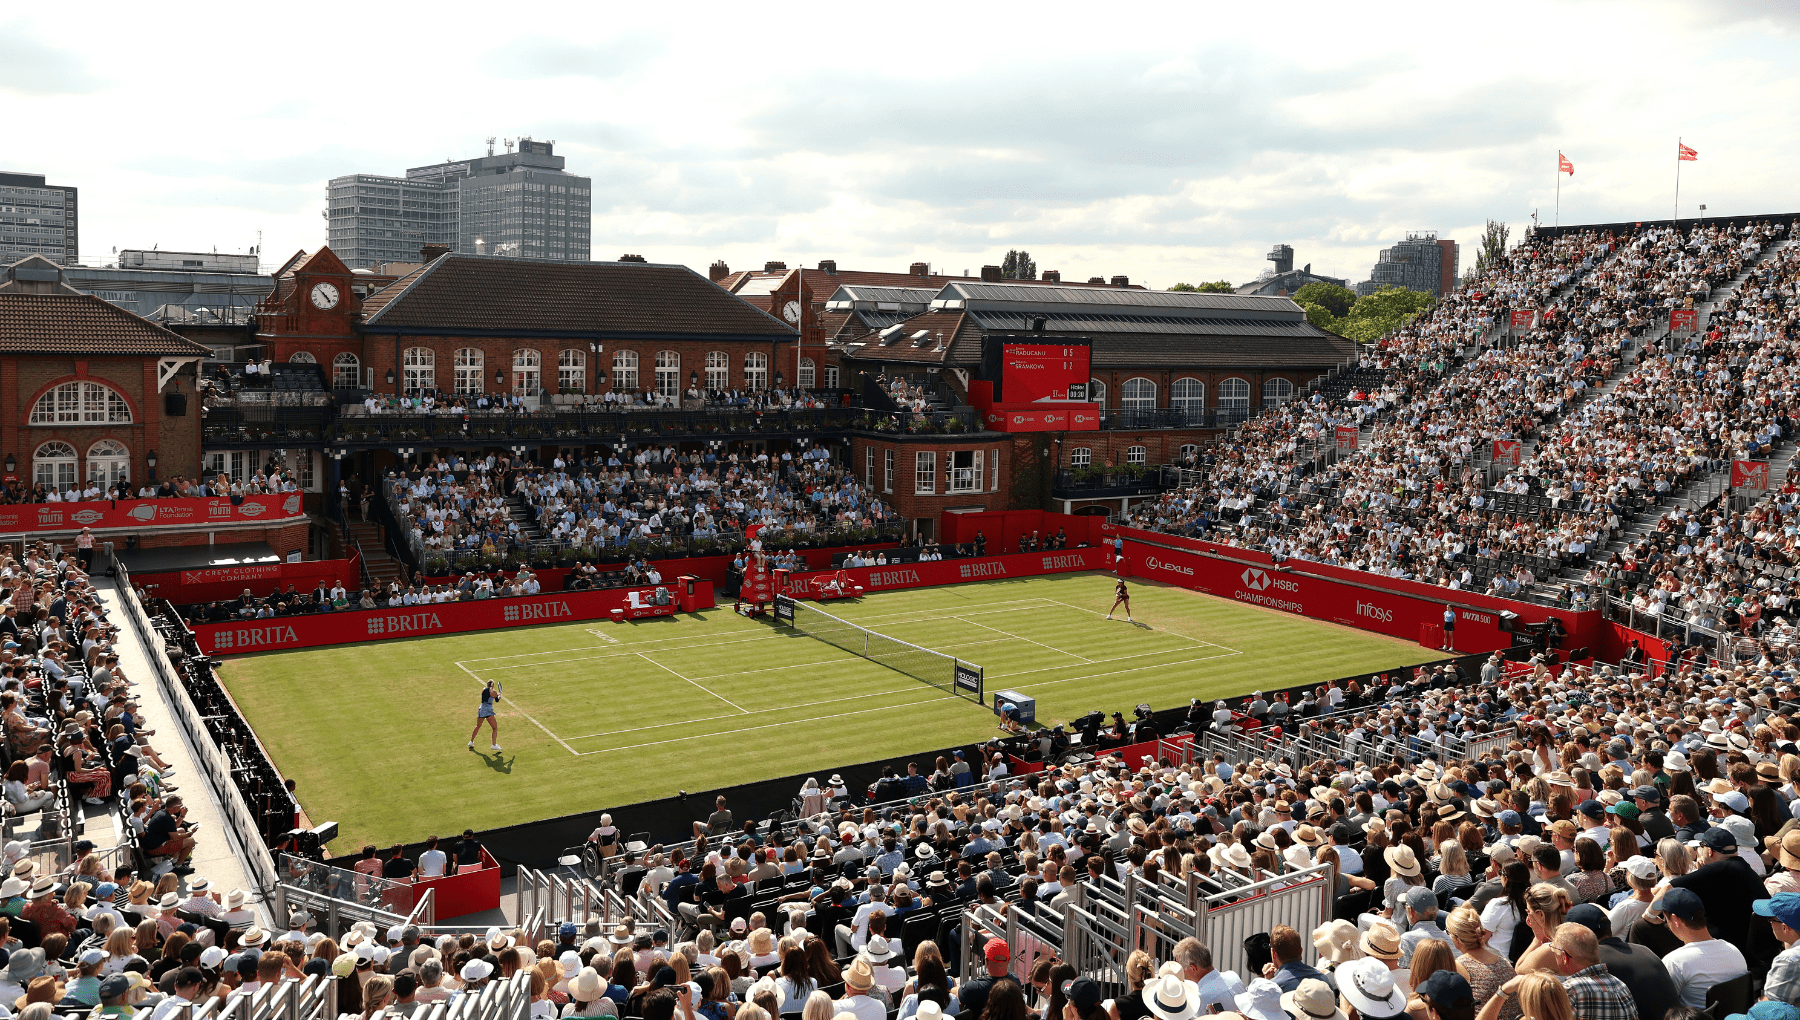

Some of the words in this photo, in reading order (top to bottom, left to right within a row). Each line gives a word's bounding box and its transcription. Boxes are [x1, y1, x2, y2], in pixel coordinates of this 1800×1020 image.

[1063, 348, 1068, 357] 0
[1069, 348, 1074, 357] 5
[159, 511, 194, 519] Foundation
[208, 506, 231, 515] YOUTH
[38, 514, 63, 523] YOUTH
[1053, 555, 1086, 569] BRITA
[1158, 561, 1195, 576] LEXUS
[205, 569, 230, 577] CREW
[233, 565, 278, 574] CLOTHING
[972, 562, 1006, 578] BRITA
[220, 573, 263, 582] COMPANY
[882, 570, 920, 586] BRITA
[1273, 578, 1299, 593] HSBC
[1234, 590, 1303, 613] CHAMPIONSHIPS
[520, 601, 572, 620] BRITA
[1356, 600, 1393, 623] Infosys
[1462, 611, 1480, 622] WTA
[1480, 615, 1491, 624] 500
[386, 613, 443, 633] BRITA
[236, 625, 299, 647] BRITA
[1516, 635, 1534, 644] Haier
